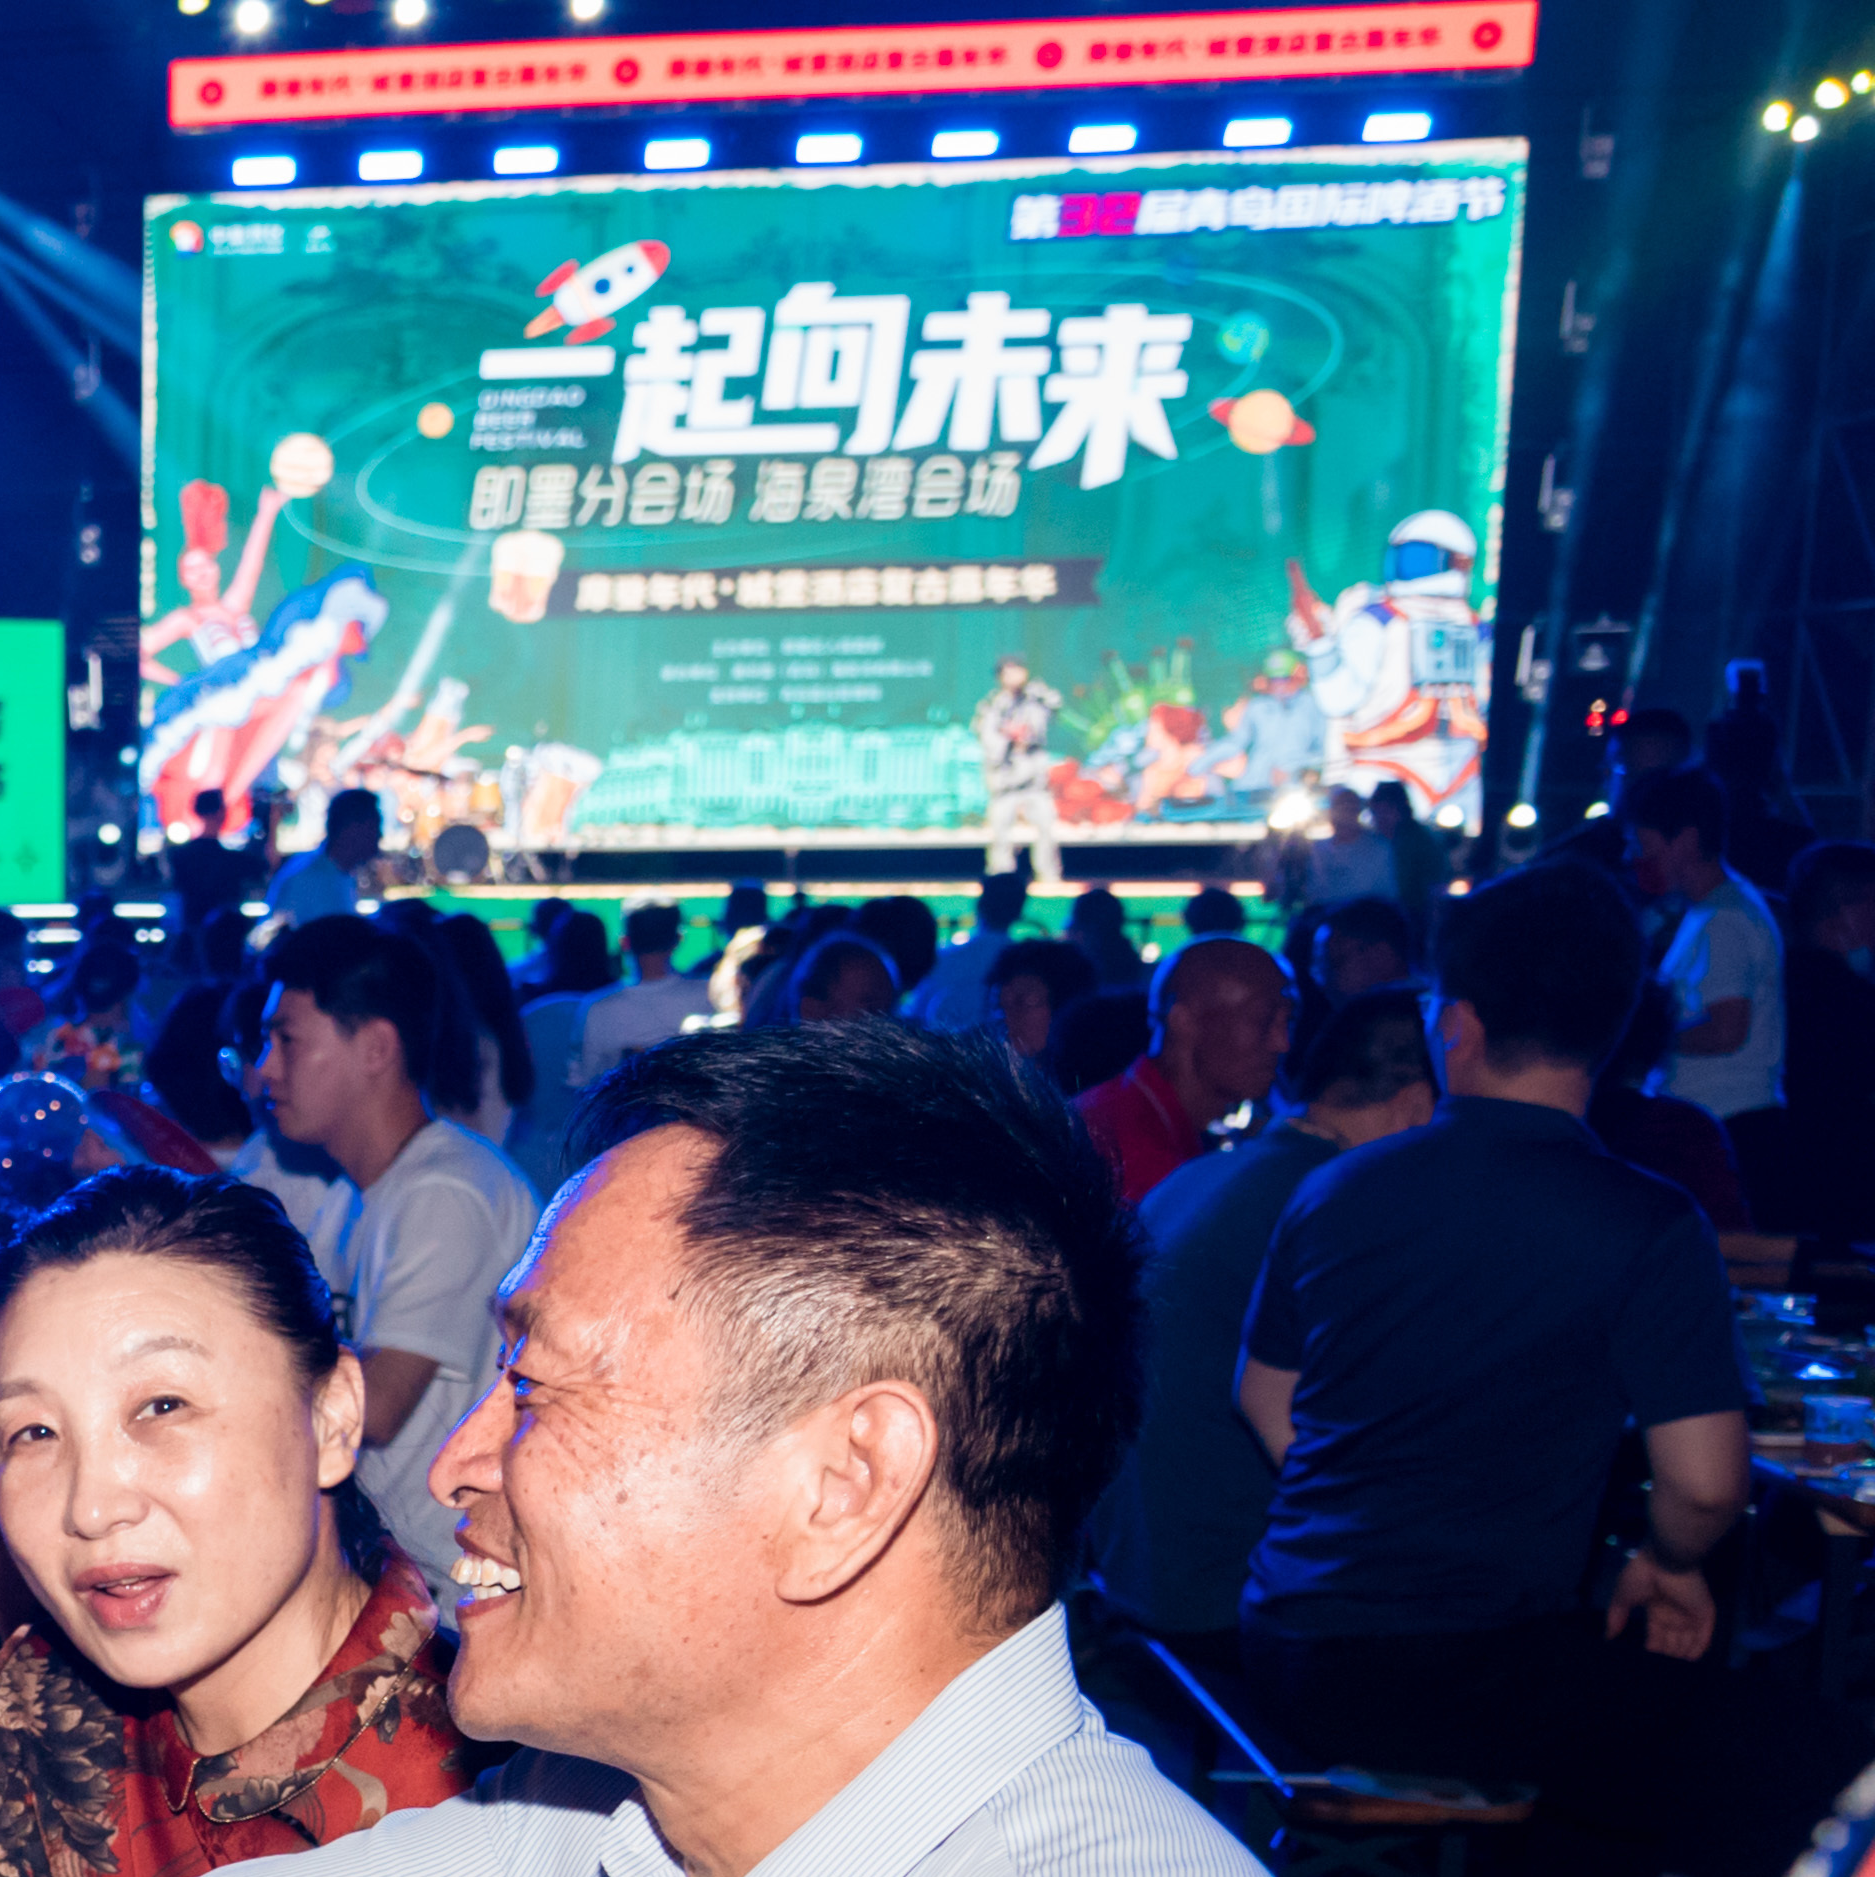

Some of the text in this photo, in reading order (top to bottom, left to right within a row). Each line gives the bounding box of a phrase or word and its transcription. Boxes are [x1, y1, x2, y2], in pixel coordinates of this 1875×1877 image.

[478, 282, 1194, 491] 一起向未来
